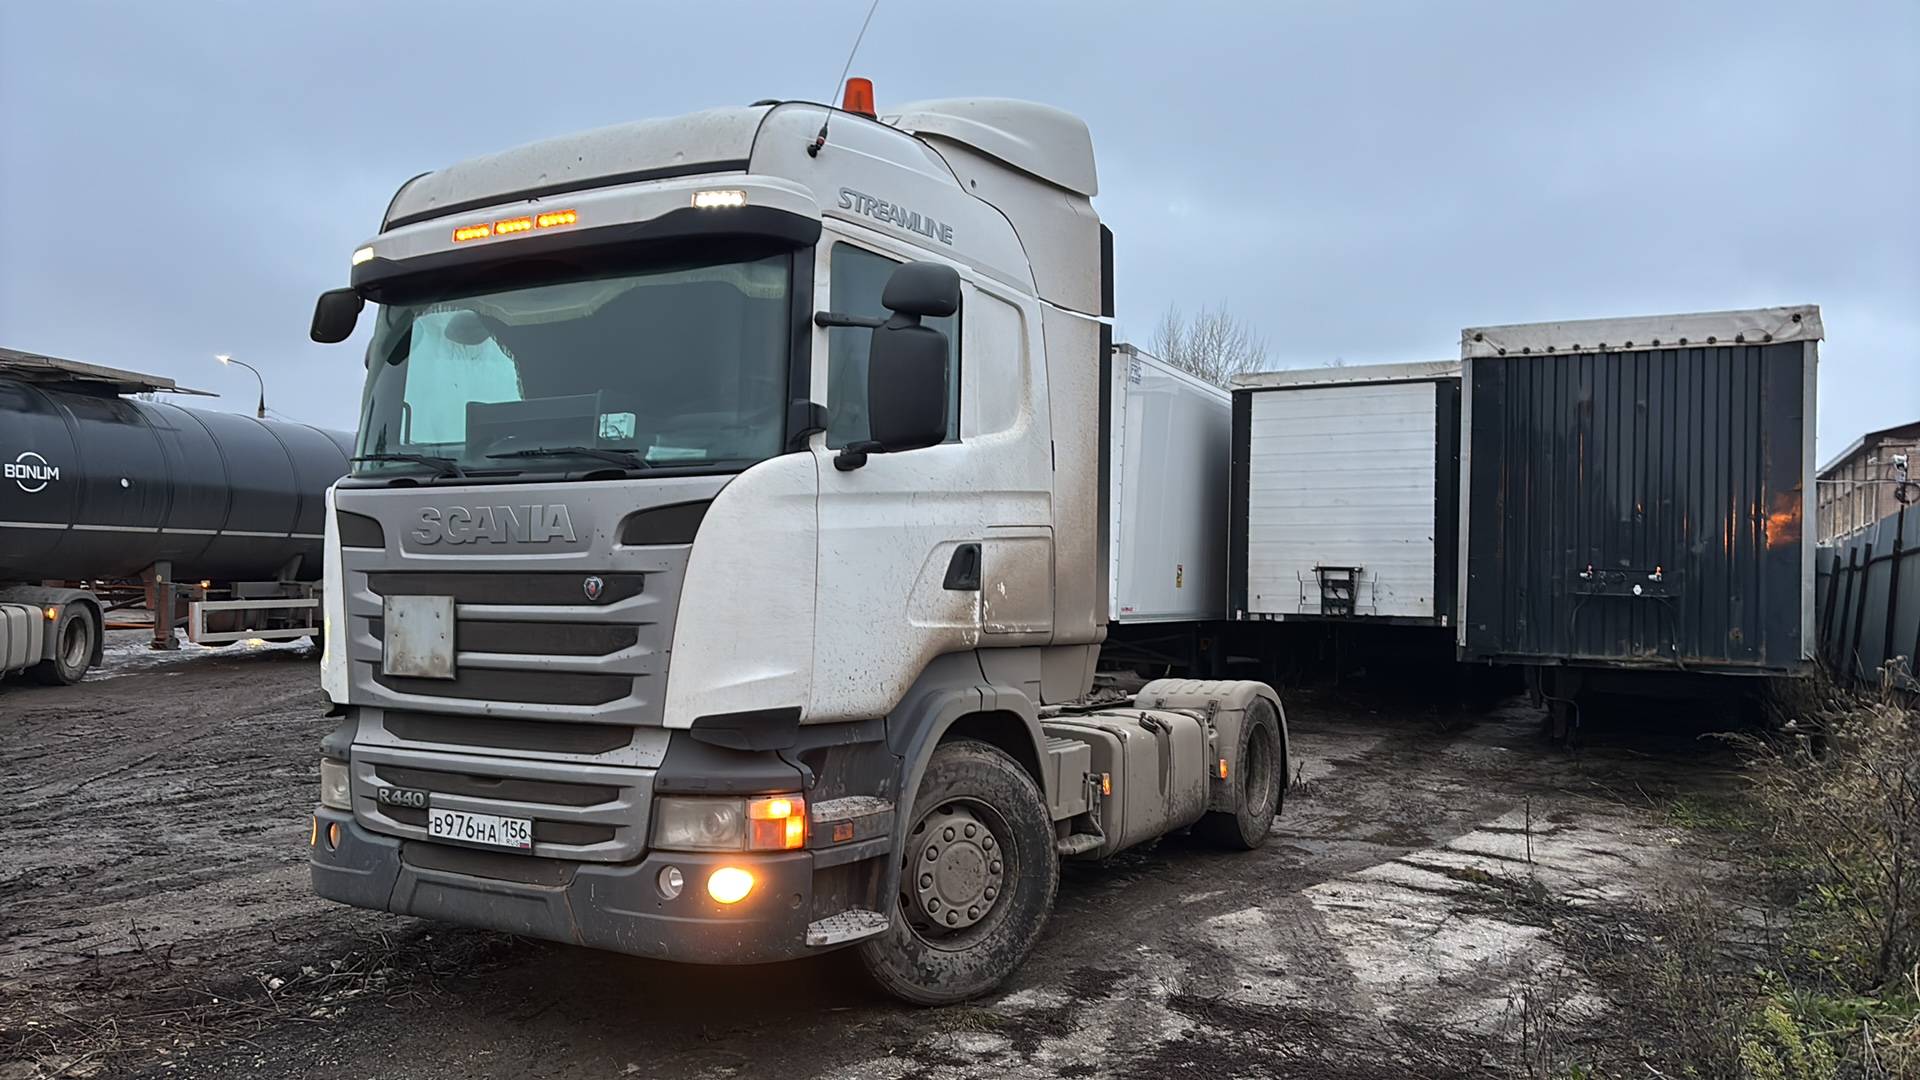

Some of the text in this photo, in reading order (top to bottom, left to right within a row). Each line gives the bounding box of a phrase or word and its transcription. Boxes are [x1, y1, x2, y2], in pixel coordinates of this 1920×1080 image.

[838, 187, 953, 246] STREAMLINE
[4, 463, 60, 480] BONUM
[411, 503, 578, 546] SCANIA
[378, 787, 425, 808] R440
